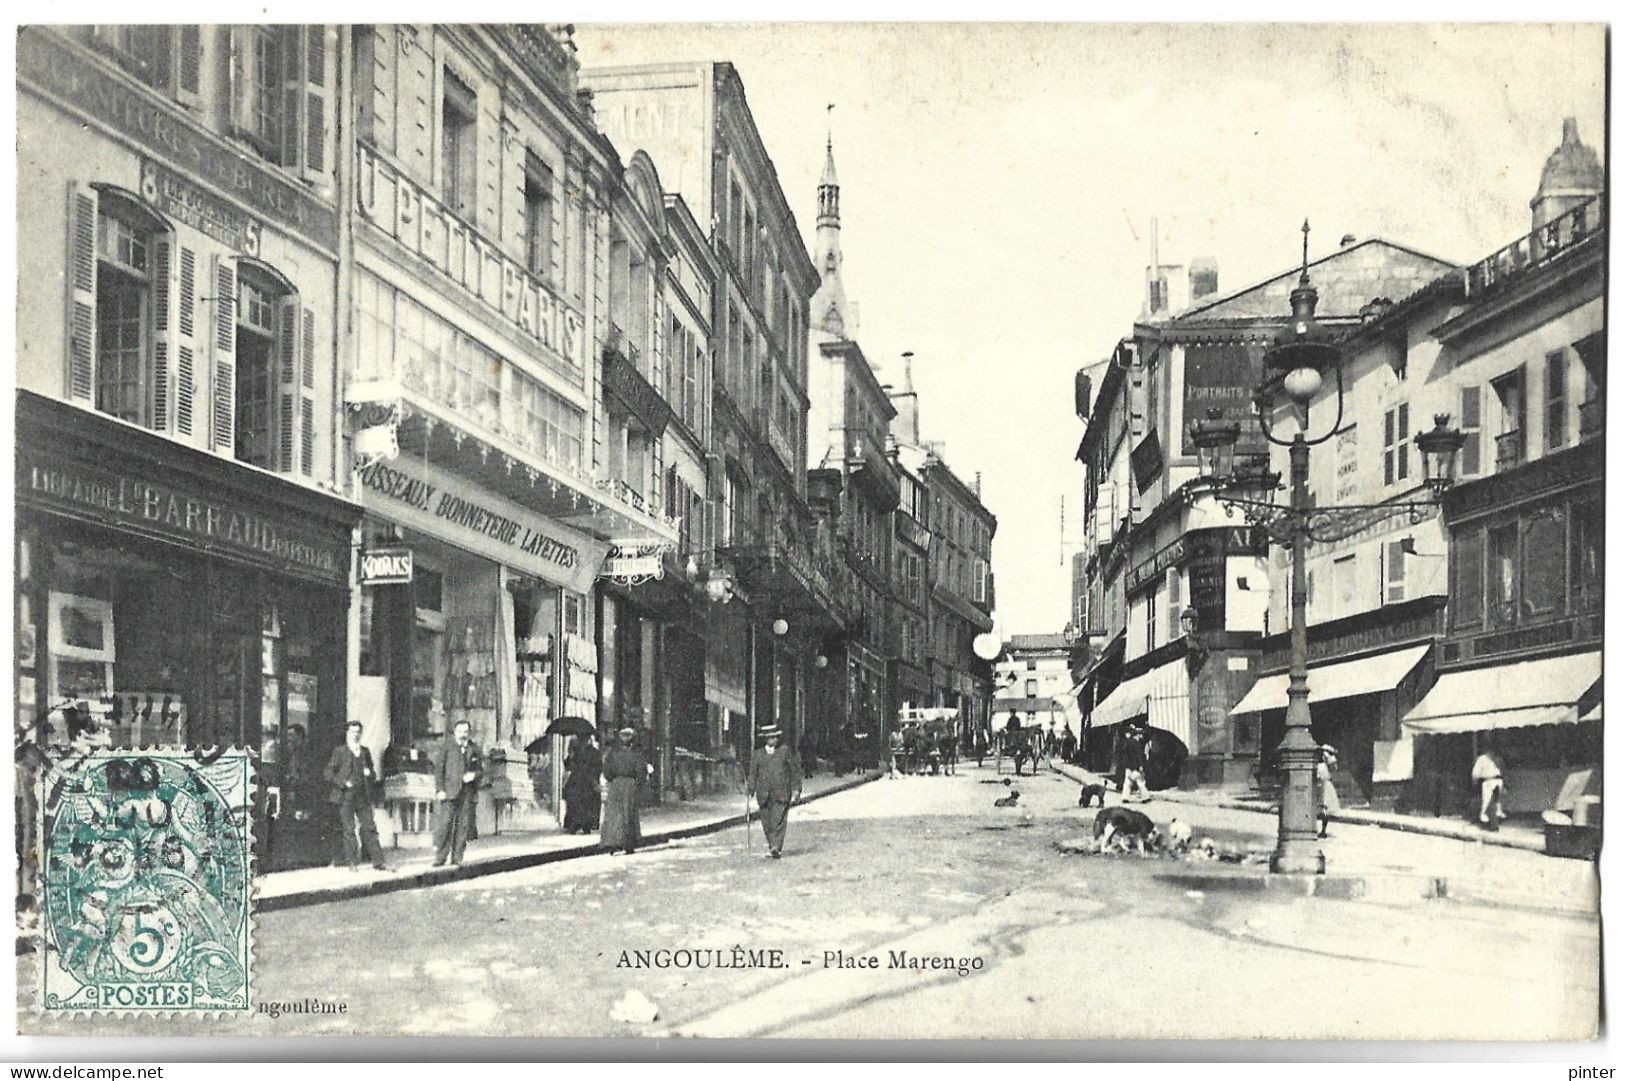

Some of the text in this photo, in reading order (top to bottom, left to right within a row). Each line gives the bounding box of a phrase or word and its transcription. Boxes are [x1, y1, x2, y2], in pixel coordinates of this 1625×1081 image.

[500, 260, 585, 372] PARIS
[1188, 384, 1243, 400] PORTRAITS
[144, 487, 277, 552] BARRAUD
[435, 492, 522, 546] BONNETERIE
[520, 528, 578, 569] LAYETTES
[361, 555, 409, 579] KODAKS
[823, 950, 879, 969] Place
[887, 950, 984, 977] Marengo
[102, 985, 189, 1006] POSTES
